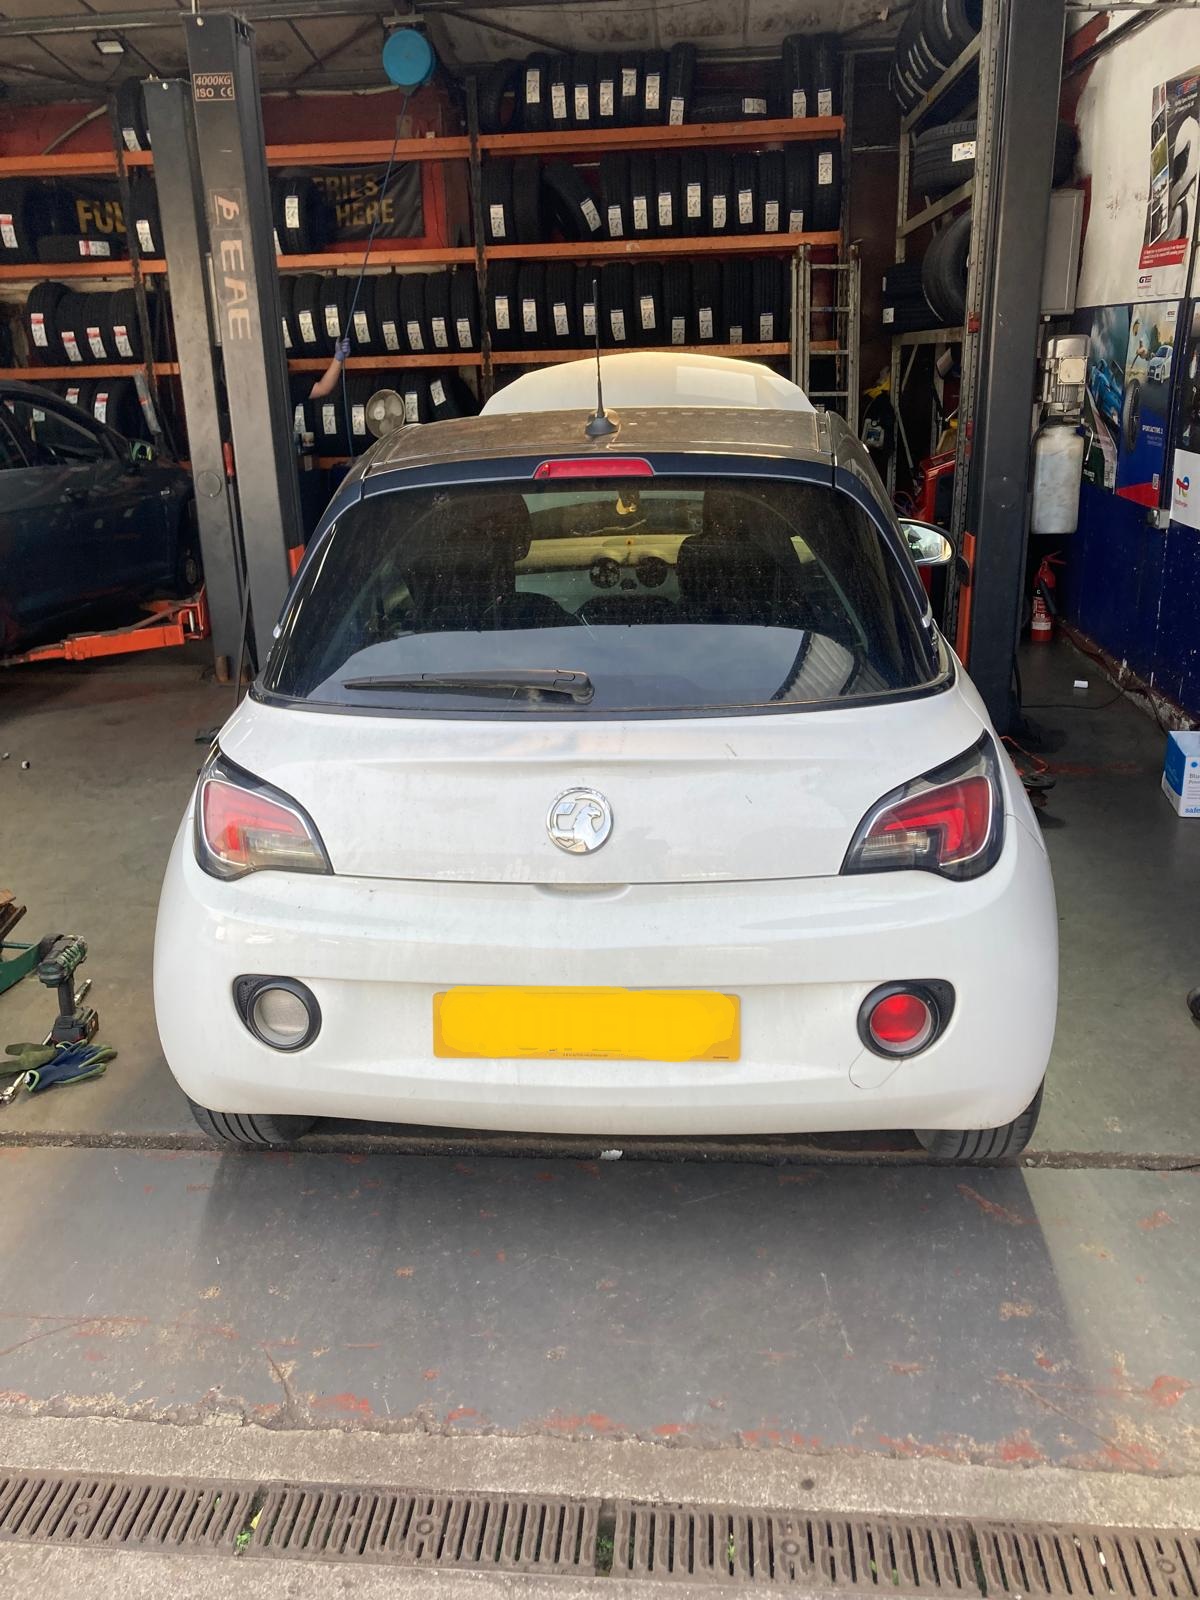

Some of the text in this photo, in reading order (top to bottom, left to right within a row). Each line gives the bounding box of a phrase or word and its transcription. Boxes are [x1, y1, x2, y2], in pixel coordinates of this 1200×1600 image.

[195, 75, 231, 86] 4000KG
[196, 87, 214, 98] ISO
[335, 199, 395, 227] HERE
